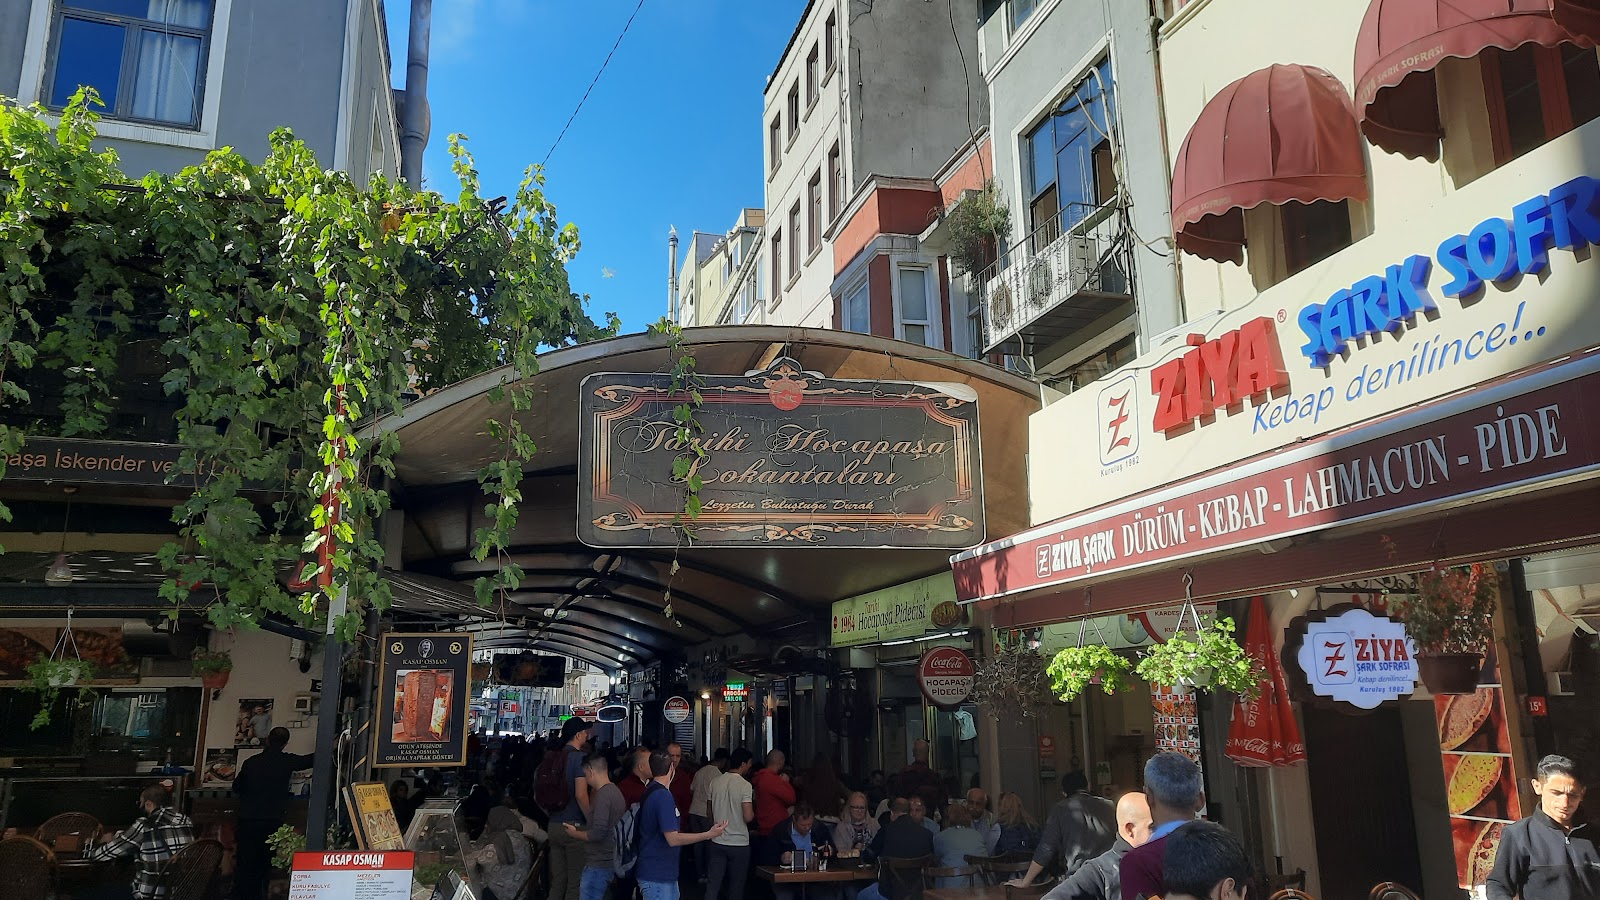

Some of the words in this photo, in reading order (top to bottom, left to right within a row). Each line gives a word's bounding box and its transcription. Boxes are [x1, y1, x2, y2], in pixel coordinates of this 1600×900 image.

[1401, 45, 1444, 69] SOFRASI
[1151, 316, 1286, 436] ZİYA
[1298, 254, 1434, 369] ŞARK
[1252, 386, 1335, 435] Kebap
[1345, 301, 1546, 403] denilince!..
[764, 424, 954, 467] Hocapaşa
[3, 452, 47, 471] aşa
[54, 448, 146, 473] İskender
[152, 460, 173, 474] ve
[669, 452, 903, 485] Lokantaları
[1100, 464, 1123, 478] Kuruluş
[1052, 534, 1082, 572] ZİYA
[1082, 529, 1117, 573] ŞARK
[1121, 505, 1188, 557] DÜRÜM
[1197, 486, 1269, 539] KEBAP
[1283, 435, 1450, 519] LAHMACUN
[1474, 404, 1568, 474] PİDE
[701, 499, 756, 512] Lezzetin
[833, 499, 875, 511] Durak
[858, 609, 893, 633] Hocapaşa
[895, 596, 926, 625] Pidecisi
[864, 598, 880, 614] Tarihi
[1354, 633, 1409, 661] ZİYA
[1356, 662, 1377, 675] ŞARK
[1379, 661, 1410, 671] SOFRASI
[1357, 676, 1377, 684] Kebap
[322, 853, 352, 866] KASAP
[353, 853, 385, 866] OSMAN
